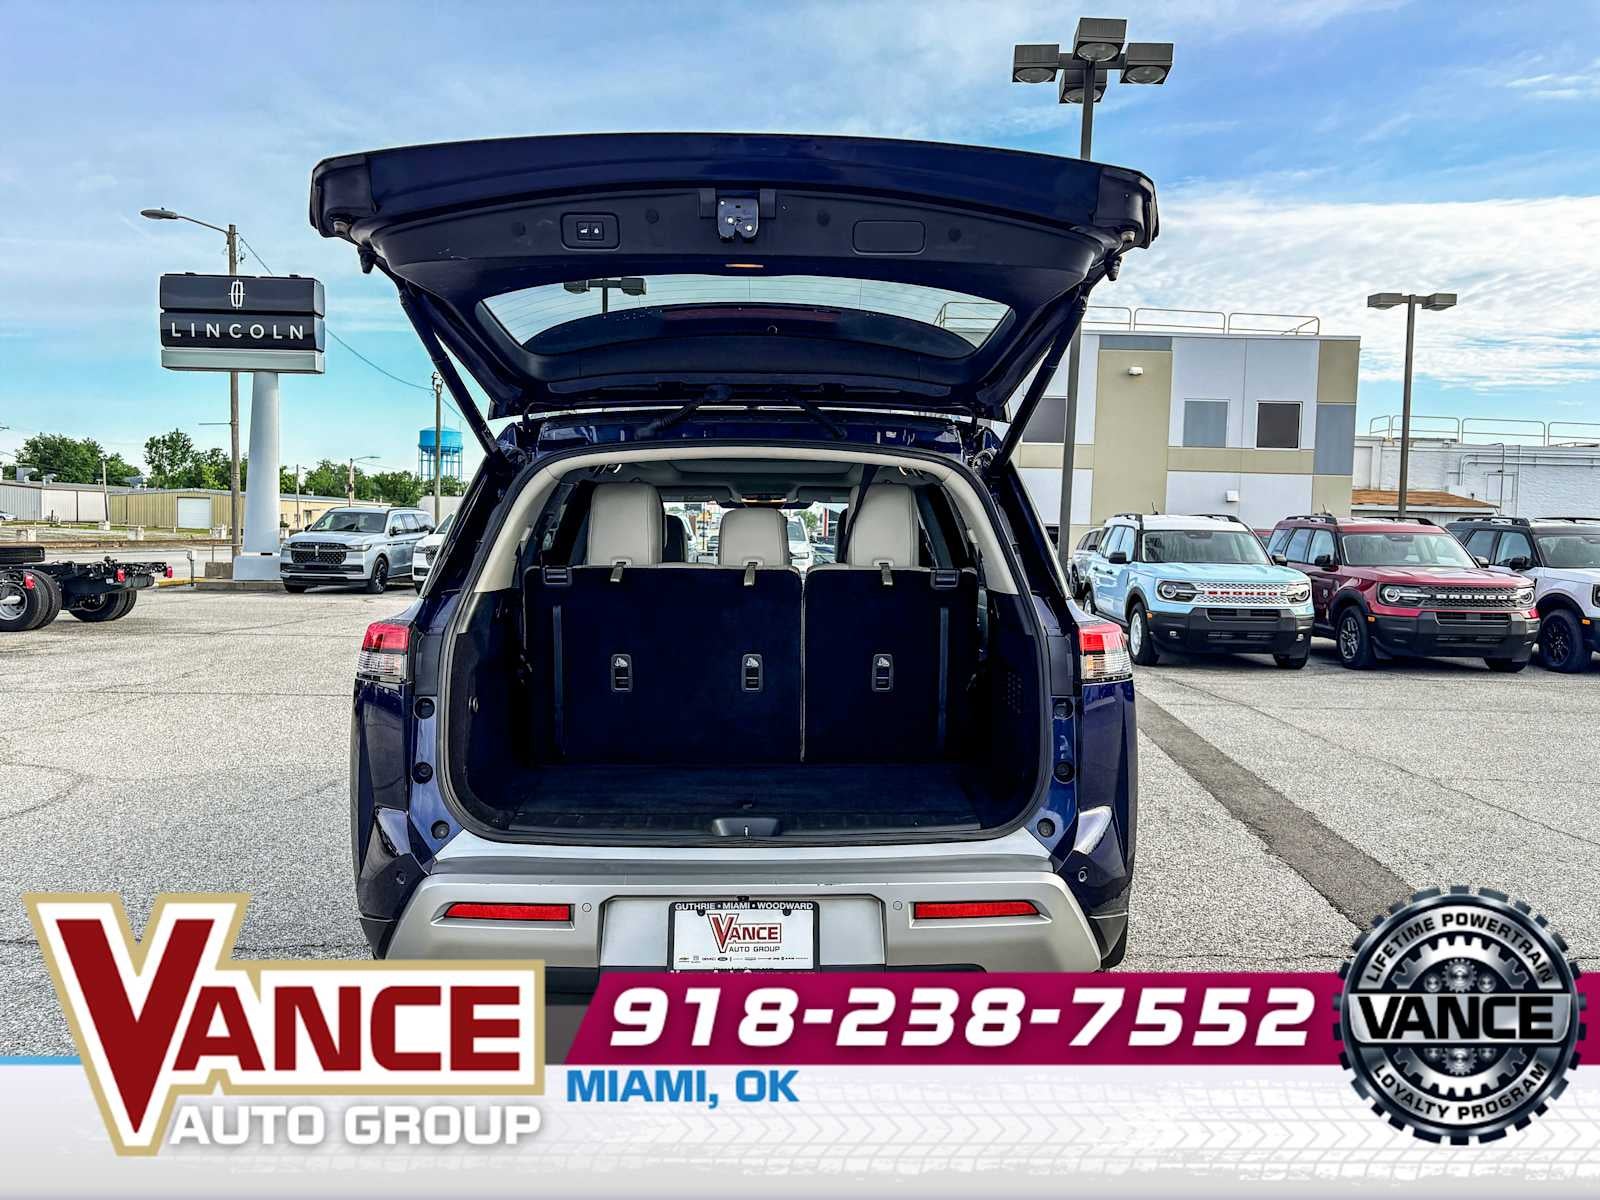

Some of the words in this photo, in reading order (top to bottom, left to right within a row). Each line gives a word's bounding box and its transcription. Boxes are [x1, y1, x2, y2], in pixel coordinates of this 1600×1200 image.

[171, 322, 304, 340] LINCOLN
[675, 902, 715, 910] GUTHRIE
[722, 902, 751, 910] MIAMI
[757, 902, 813, 910] WOODWARD
[710, 916, 779, 949] VANCE
